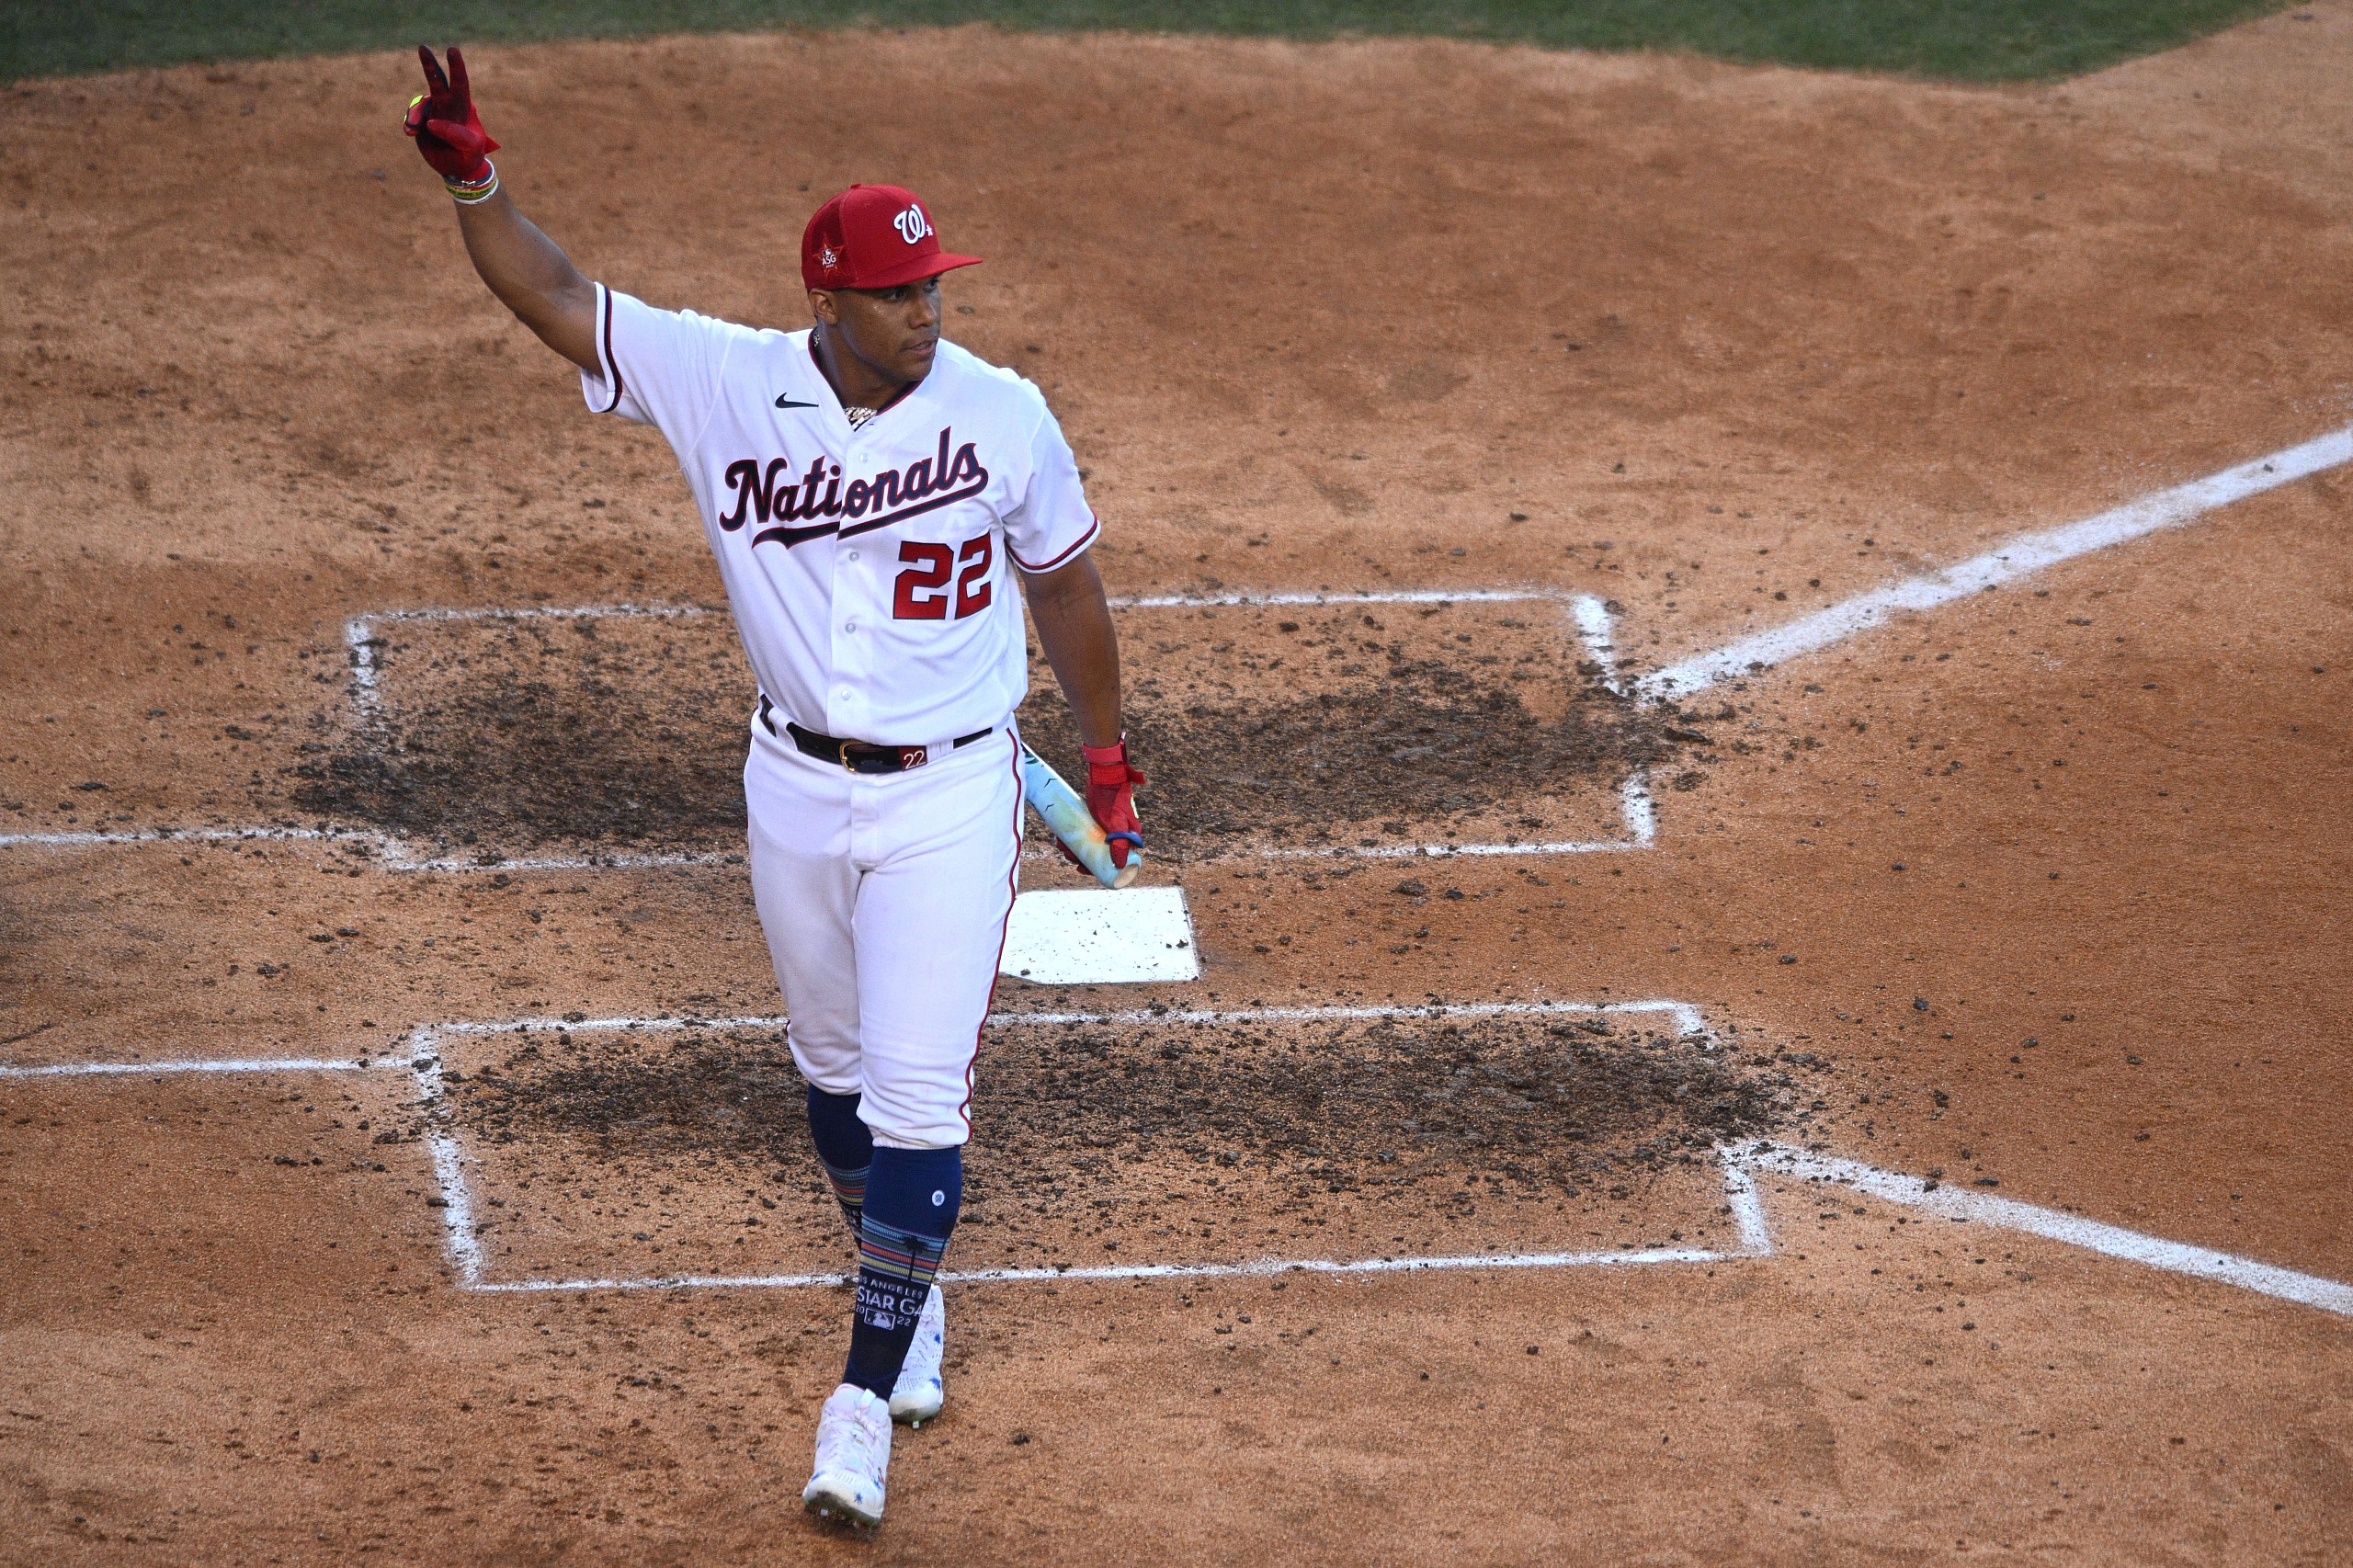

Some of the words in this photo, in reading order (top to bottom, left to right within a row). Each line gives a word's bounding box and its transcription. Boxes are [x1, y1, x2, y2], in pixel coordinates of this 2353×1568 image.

[893, 204, 926, 244] W
[822, 254, 836, 266] ASG
[719, 426, 989, 548] Nationals
[892, 531, 993, 619] 22
[903, 749, 926, 769] 22
[857, 1285, 894, 1312] STAR
[870, 1278, 923, 1299] ANGELES
[896, 1316, 911, 1327] 22
